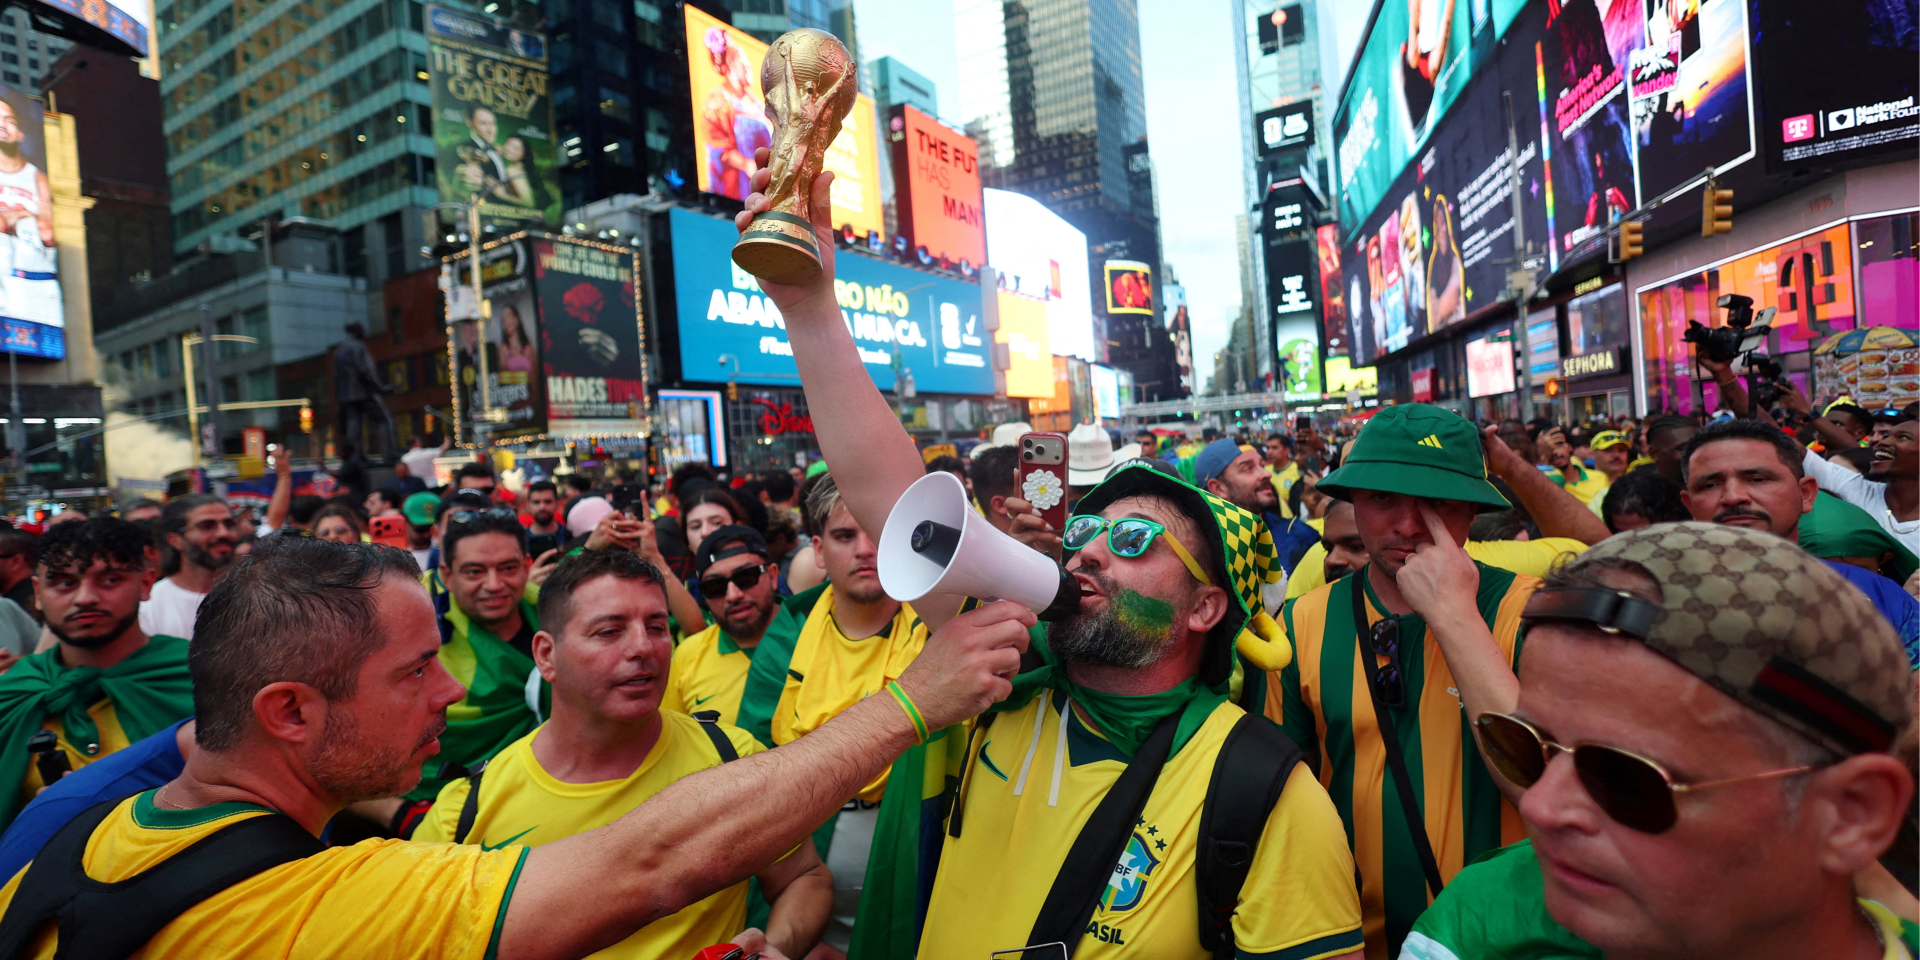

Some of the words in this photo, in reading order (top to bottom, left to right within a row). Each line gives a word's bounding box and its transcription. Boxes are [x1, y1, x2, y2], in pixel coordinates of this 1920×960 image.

[434, 48, 473, 79] THE
[477, 59, 549, 95] GREAT
[1633, 71, 1677, 98] wander
[447, 75, 538, 112] GATSBY
[1555, 64, 1602, 118] America's
[1558, 101, 1579, 132] Best
[1580, 63, 1624, 114] Network
[1856, 96, 1913, 116] National
[1856, 111, 1889, 126] Park
[892, 130, 904, 142] LG
[915, 127, 949, 163] THE
[917, 156, 950, 191] HAS
[1808, 193, 1833, 213] 1535
[540, 253, 580, 274] WORLD
[582, 260, 617, 280] COULD
[575, 247, 588, 259] SEE
[1574, 276, 1603, 296] SEPHORA
[866, 284, 909, 317] NÃO
[853, 312, 927, 347] NUNCA.
[1563, 351, 1614, 377] SEPHORA
[752, 397, 816, 434] Disne
[1115, 863, 1132, 876] BF
[1084, 920, 1125, 945] ASIL
